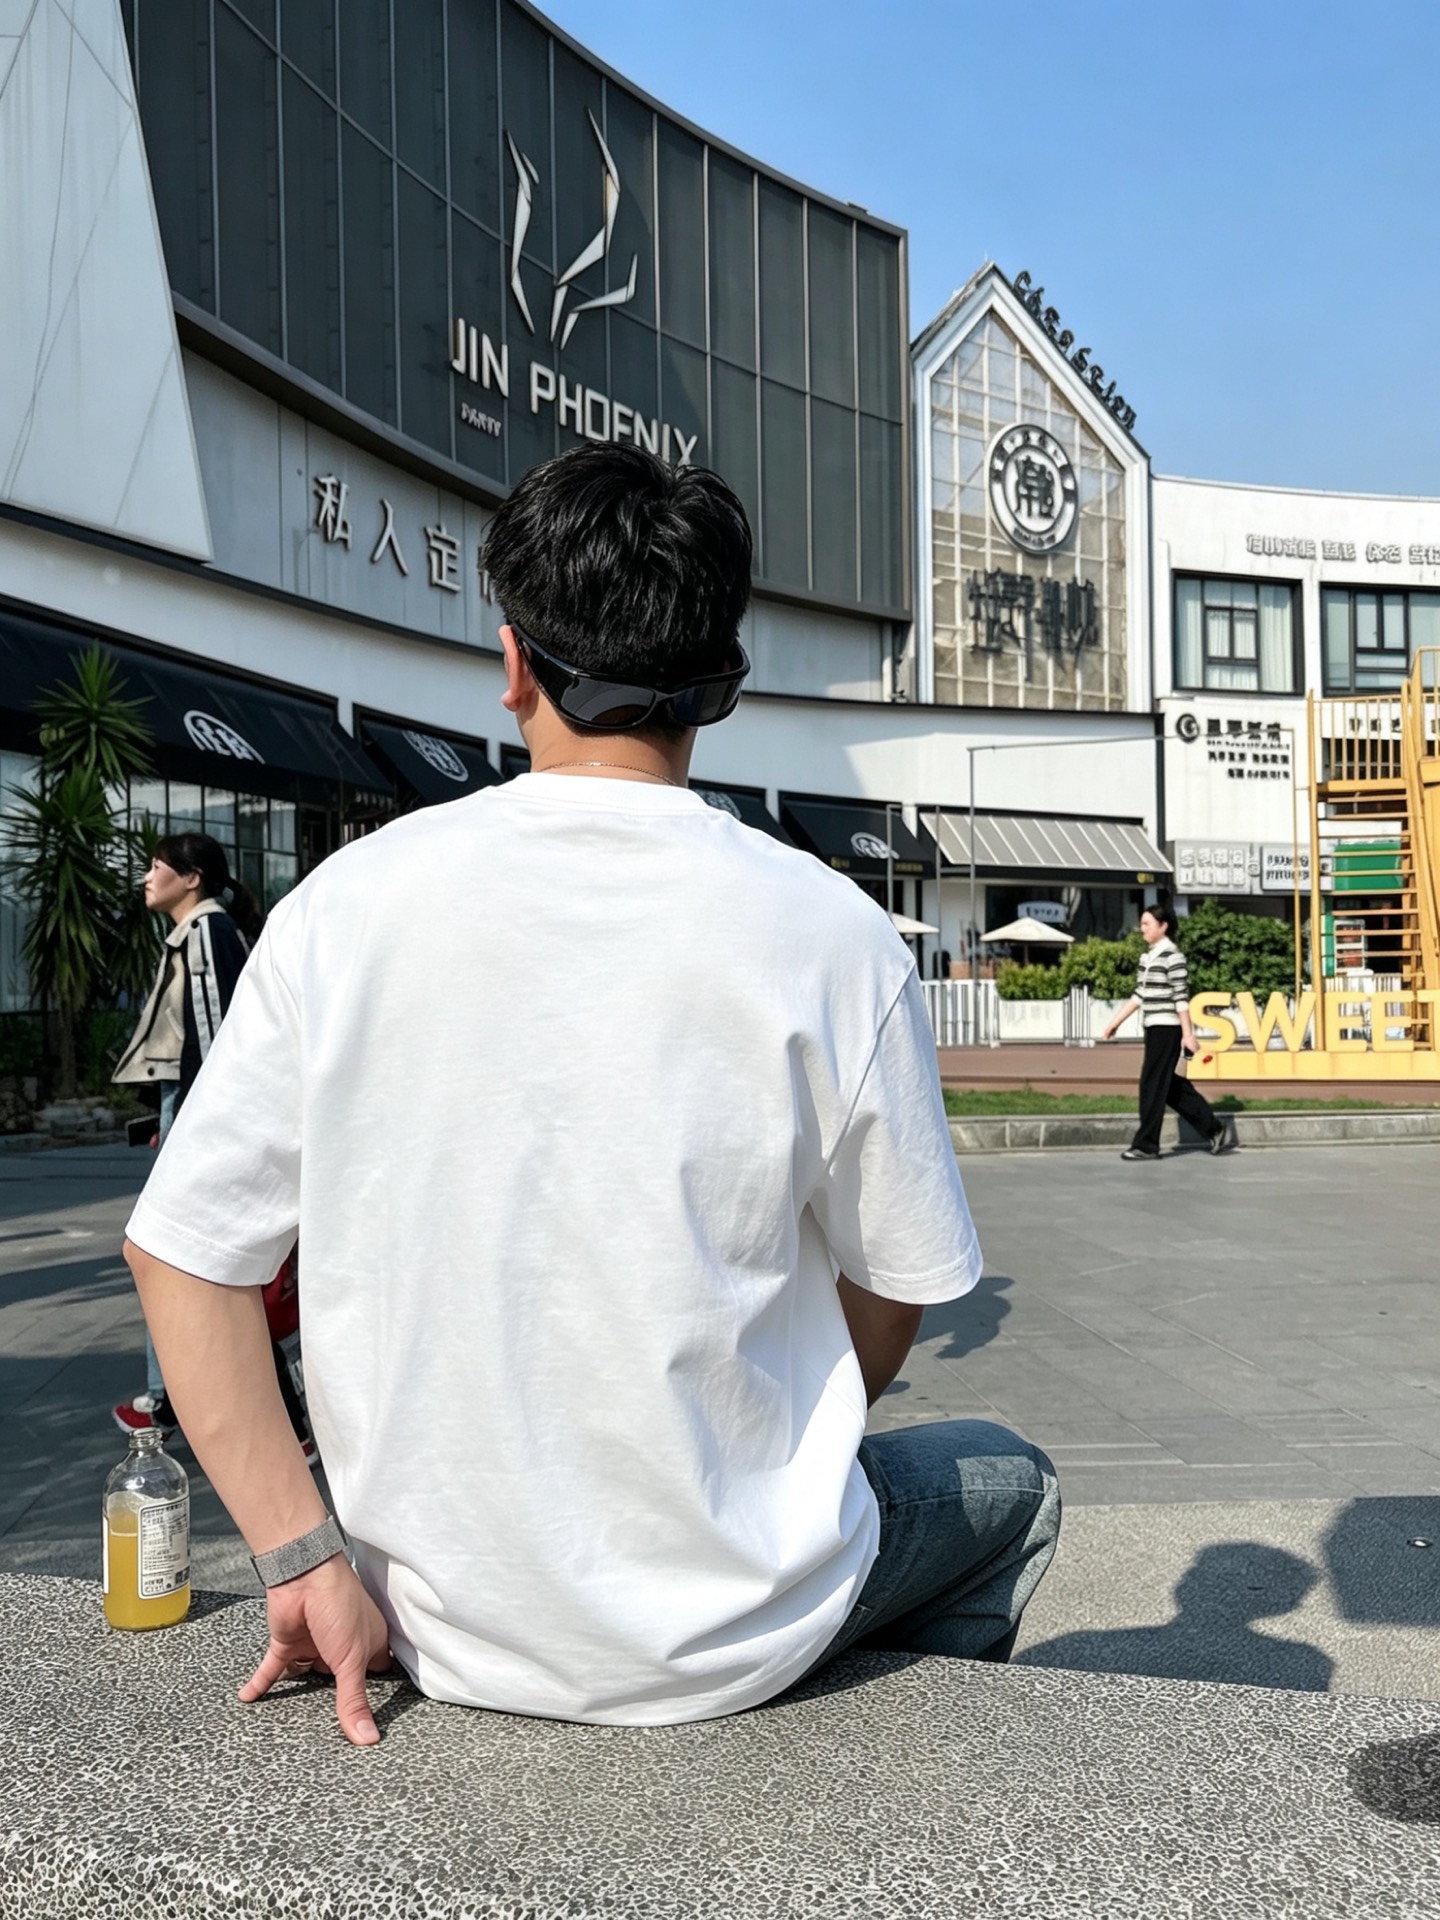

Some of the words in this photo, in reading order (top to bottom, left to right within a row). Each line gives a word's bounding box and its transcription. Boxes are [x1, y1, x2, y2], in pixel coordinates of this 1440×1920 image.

[451, 317, 509, 398] JIN
[314, 474, 498, 605] 私人定
